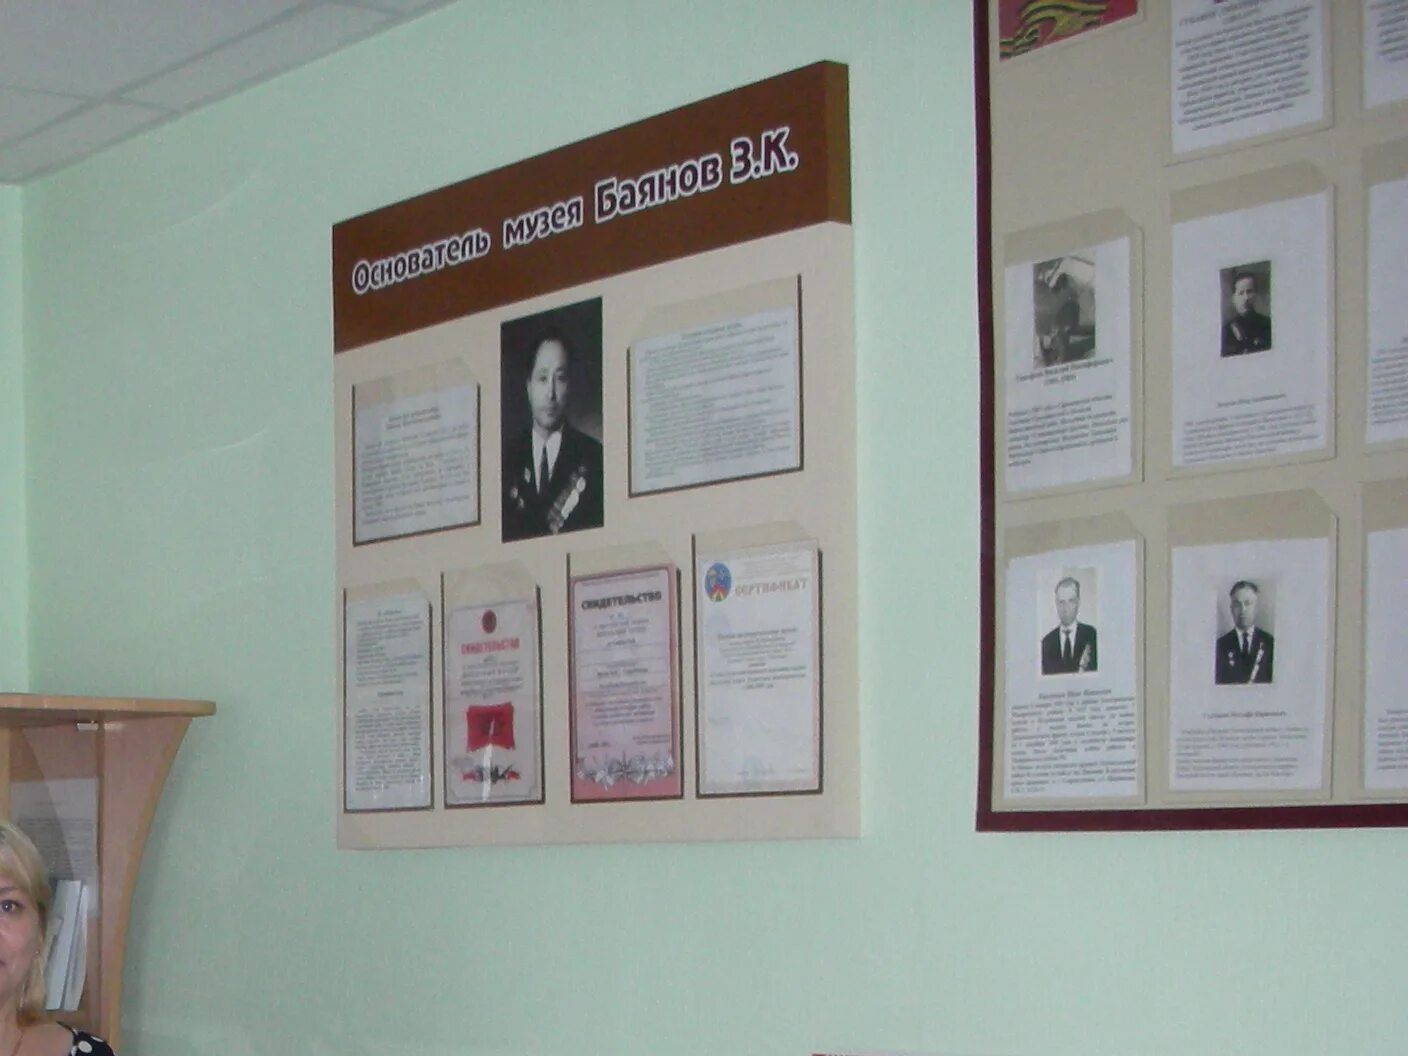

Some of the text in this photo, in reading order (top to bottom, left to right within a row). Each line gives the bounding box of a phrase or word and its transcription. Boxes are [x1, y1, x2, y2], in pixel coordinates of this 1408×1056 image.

[352, 126, 799, 295] Основатель музея Баянов З.К.
[581, 591, 662, 610] СВИДЕТЕЛЬСТВО
